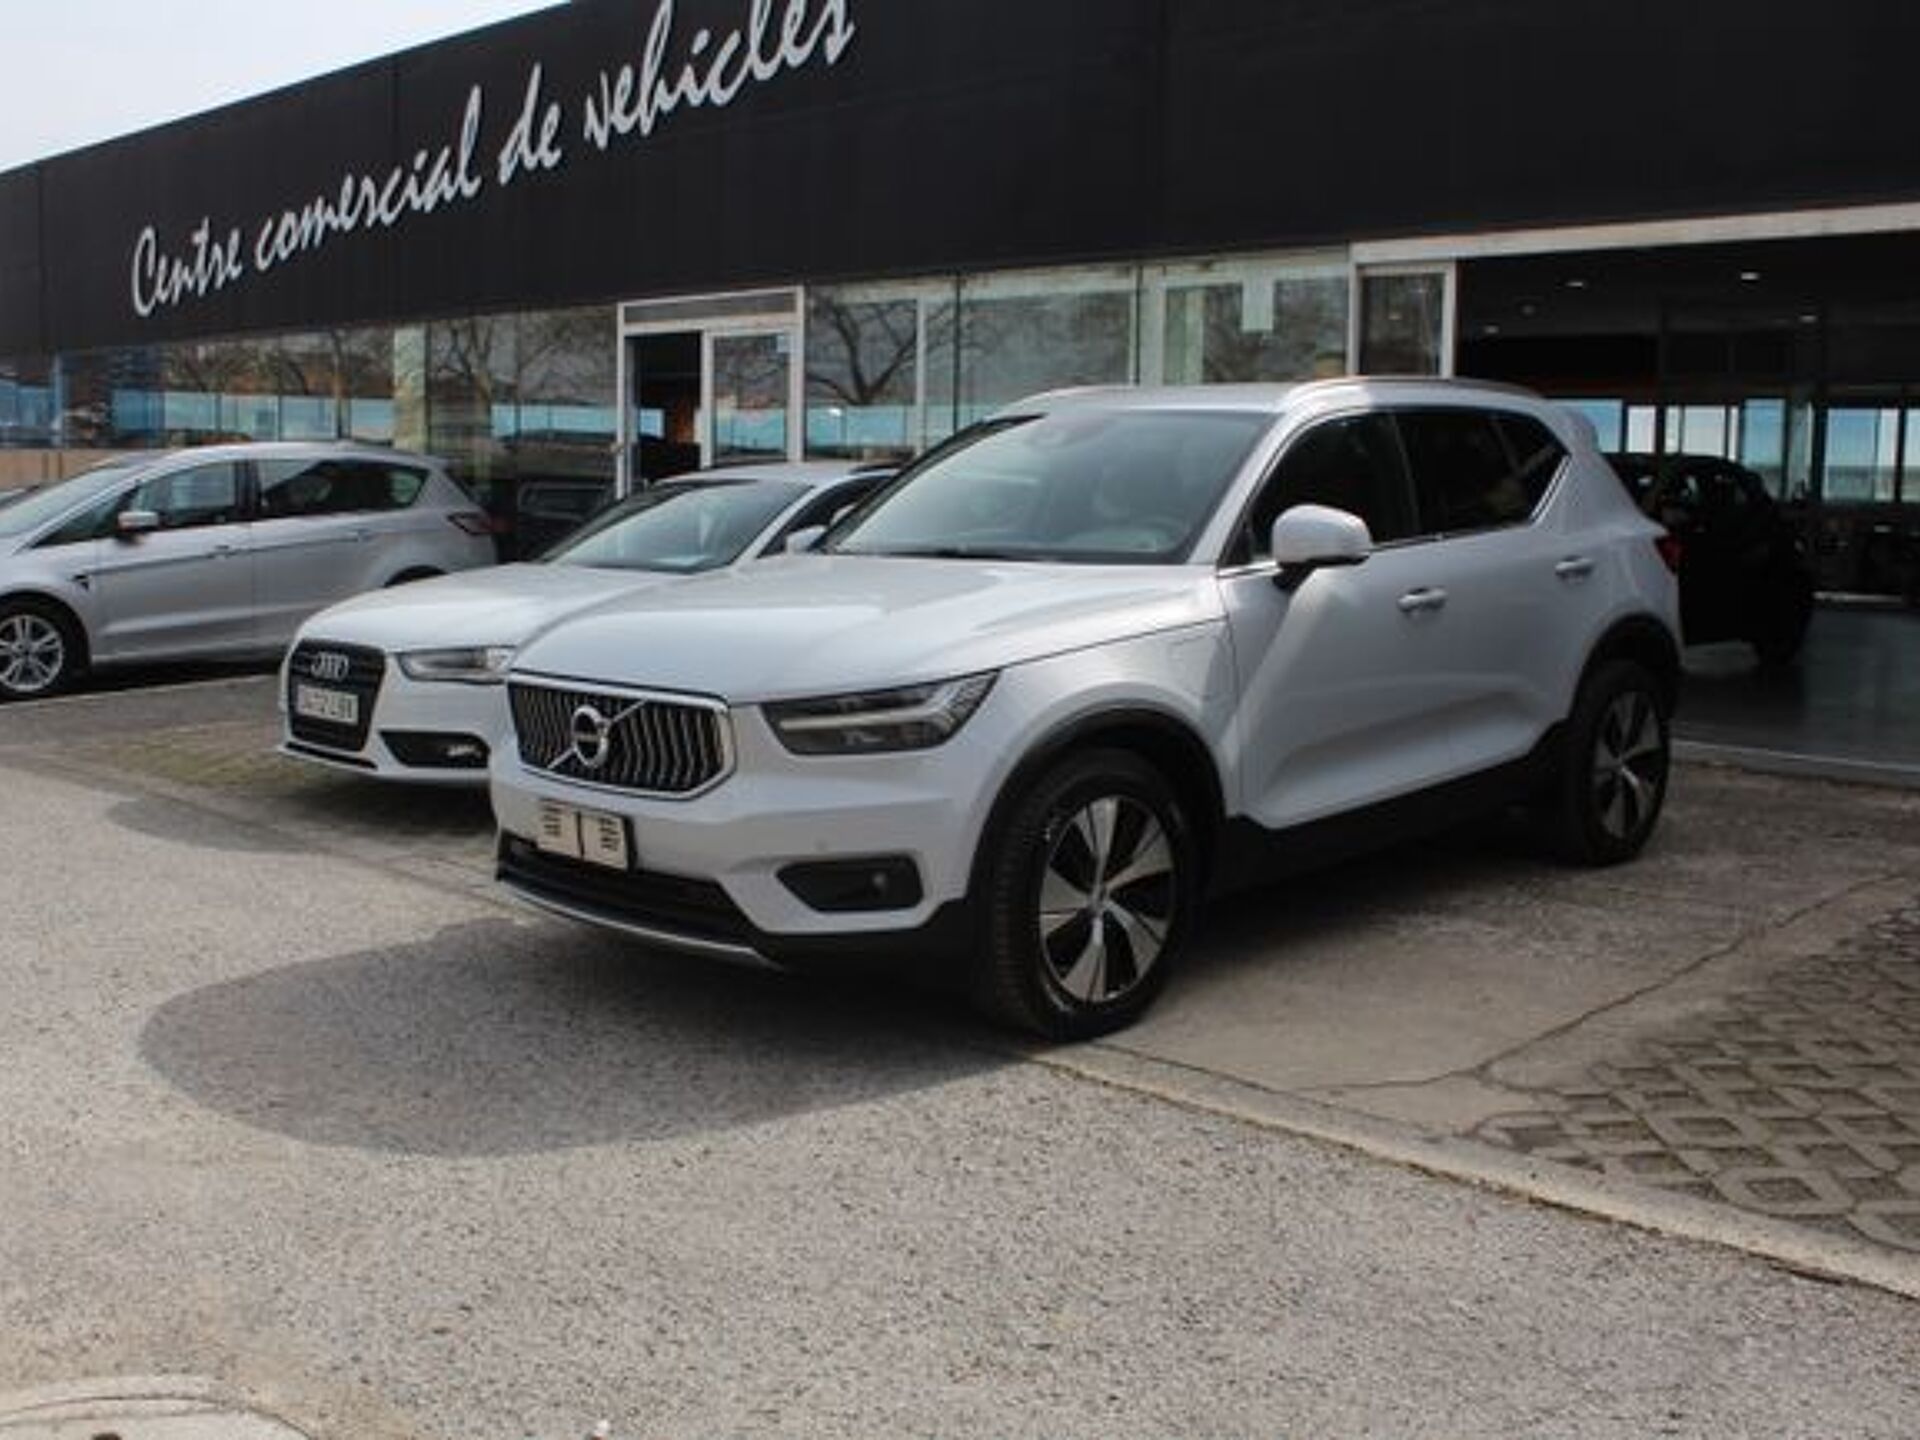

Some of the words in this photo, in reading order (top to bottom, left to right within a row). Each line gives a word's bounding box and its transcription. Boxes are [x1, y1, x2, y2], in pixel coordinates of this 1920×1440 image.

[131, 216, 243, 317] Centre
[254, 84, 482, 271] comercial
[498, 62, 562, 186] de
[583, 0, 855, 150] vehicles
